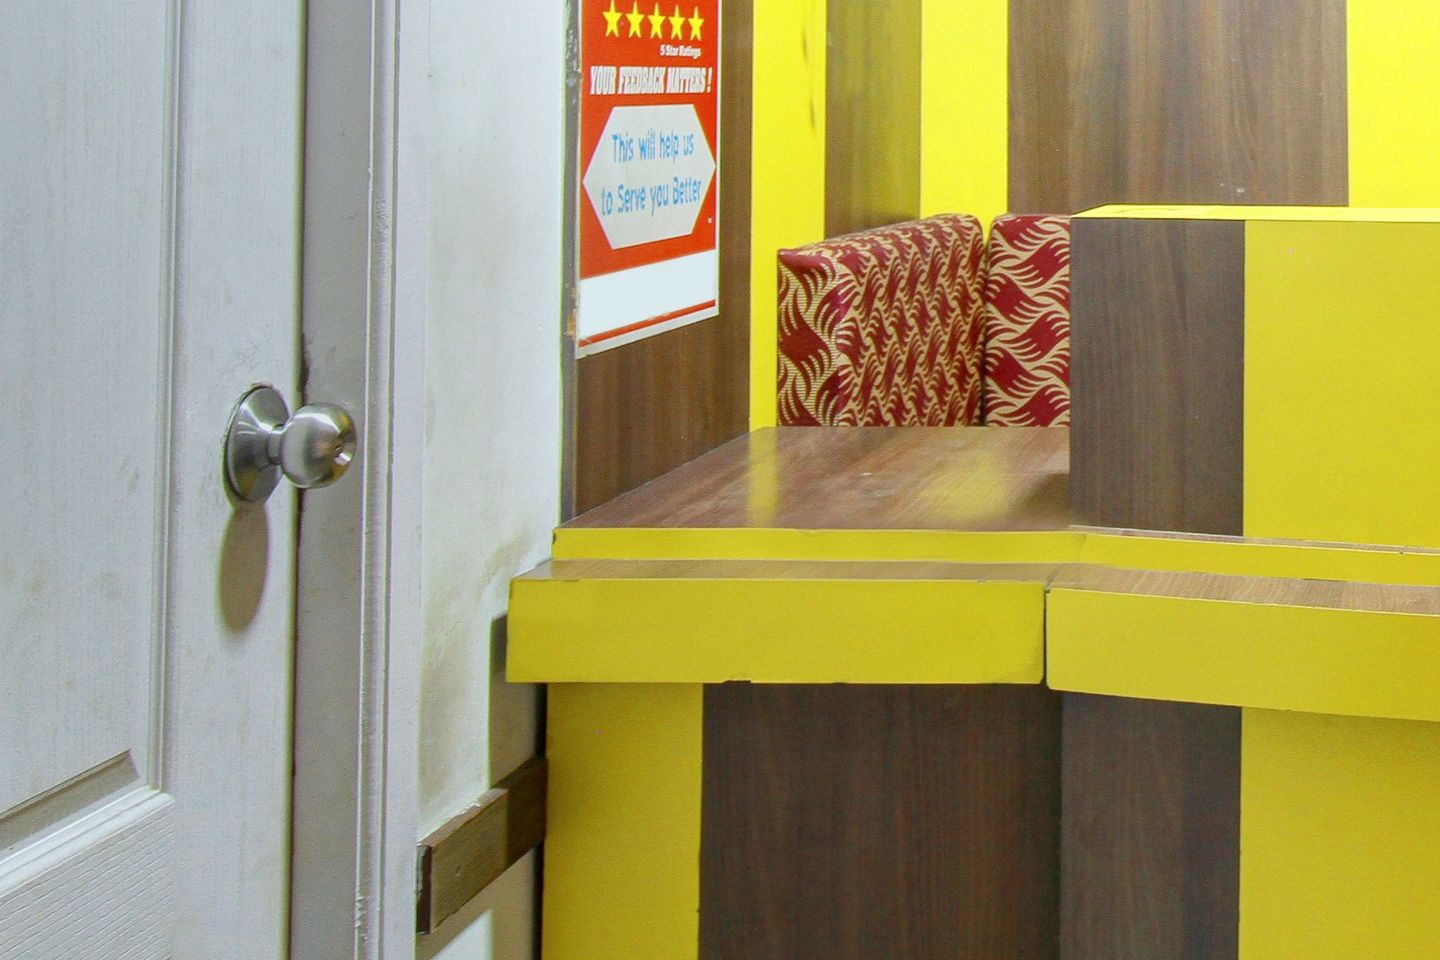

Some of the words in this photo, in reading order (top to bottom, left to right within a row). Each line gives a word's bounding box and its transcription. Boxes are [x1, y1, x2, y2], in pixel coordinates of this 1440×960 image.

[660, 45, 665, 56] 5
[666, 45, 679, 57] Star
[679, 45, 702, 59] Ratings
[590, 65, 617, 95] YOUR
[618, 66, 666, 94] FEEDBACK
[666, 66, 706, 93] MATTERS
[611, 131, 634, 163] This
[639, 128, 656, 161] will
[659, 131, 679, 165] help
[683, 132, 694, 157] us
[601, 189, 612, 216] to
[617, 184, 646, 213] Serve
[650, 184, 669, 216] you
[672, 176, 701, 205] Better
